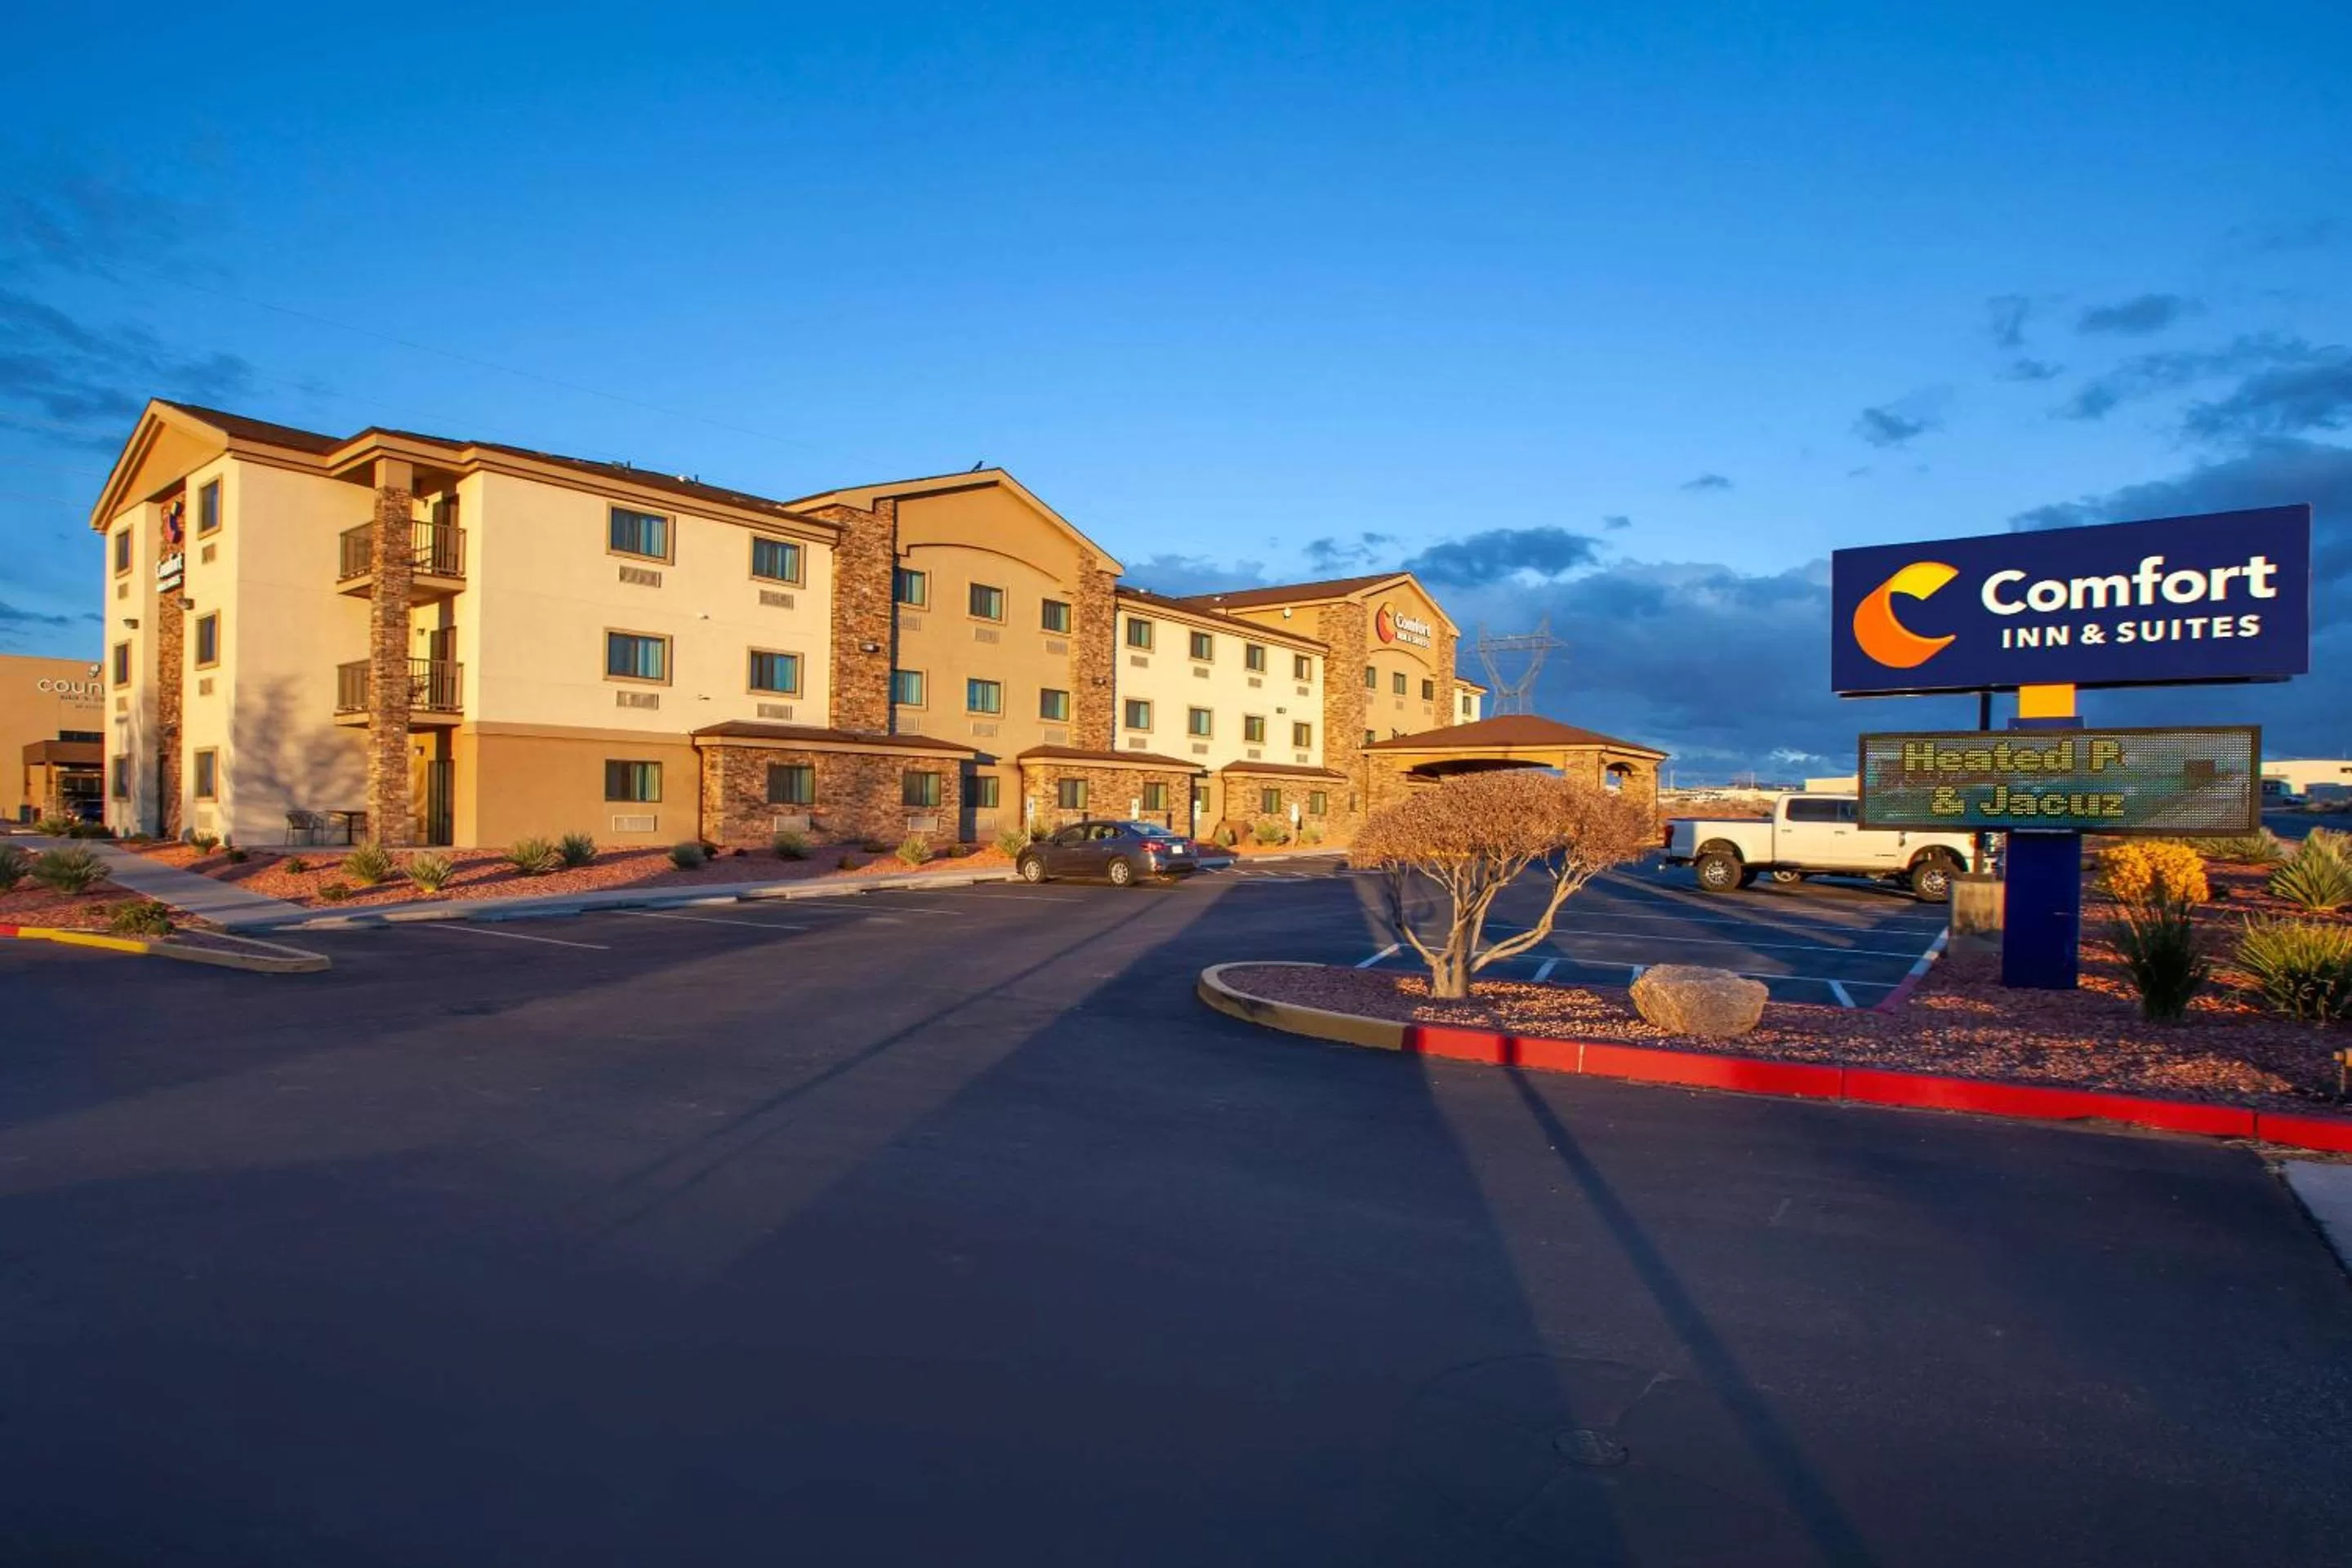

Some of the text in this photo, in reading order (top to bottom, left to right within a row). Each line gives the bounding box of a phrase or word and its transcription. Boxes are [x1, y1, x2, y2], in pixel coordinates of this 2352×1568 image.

[1981, 556, 2278, 615] Comfort
[2002, 614, 2261, 648] INN & SUITES
[1903, 741, 2074, 771] Heated
[1931, 786, 2124, 816] & Jacuz
